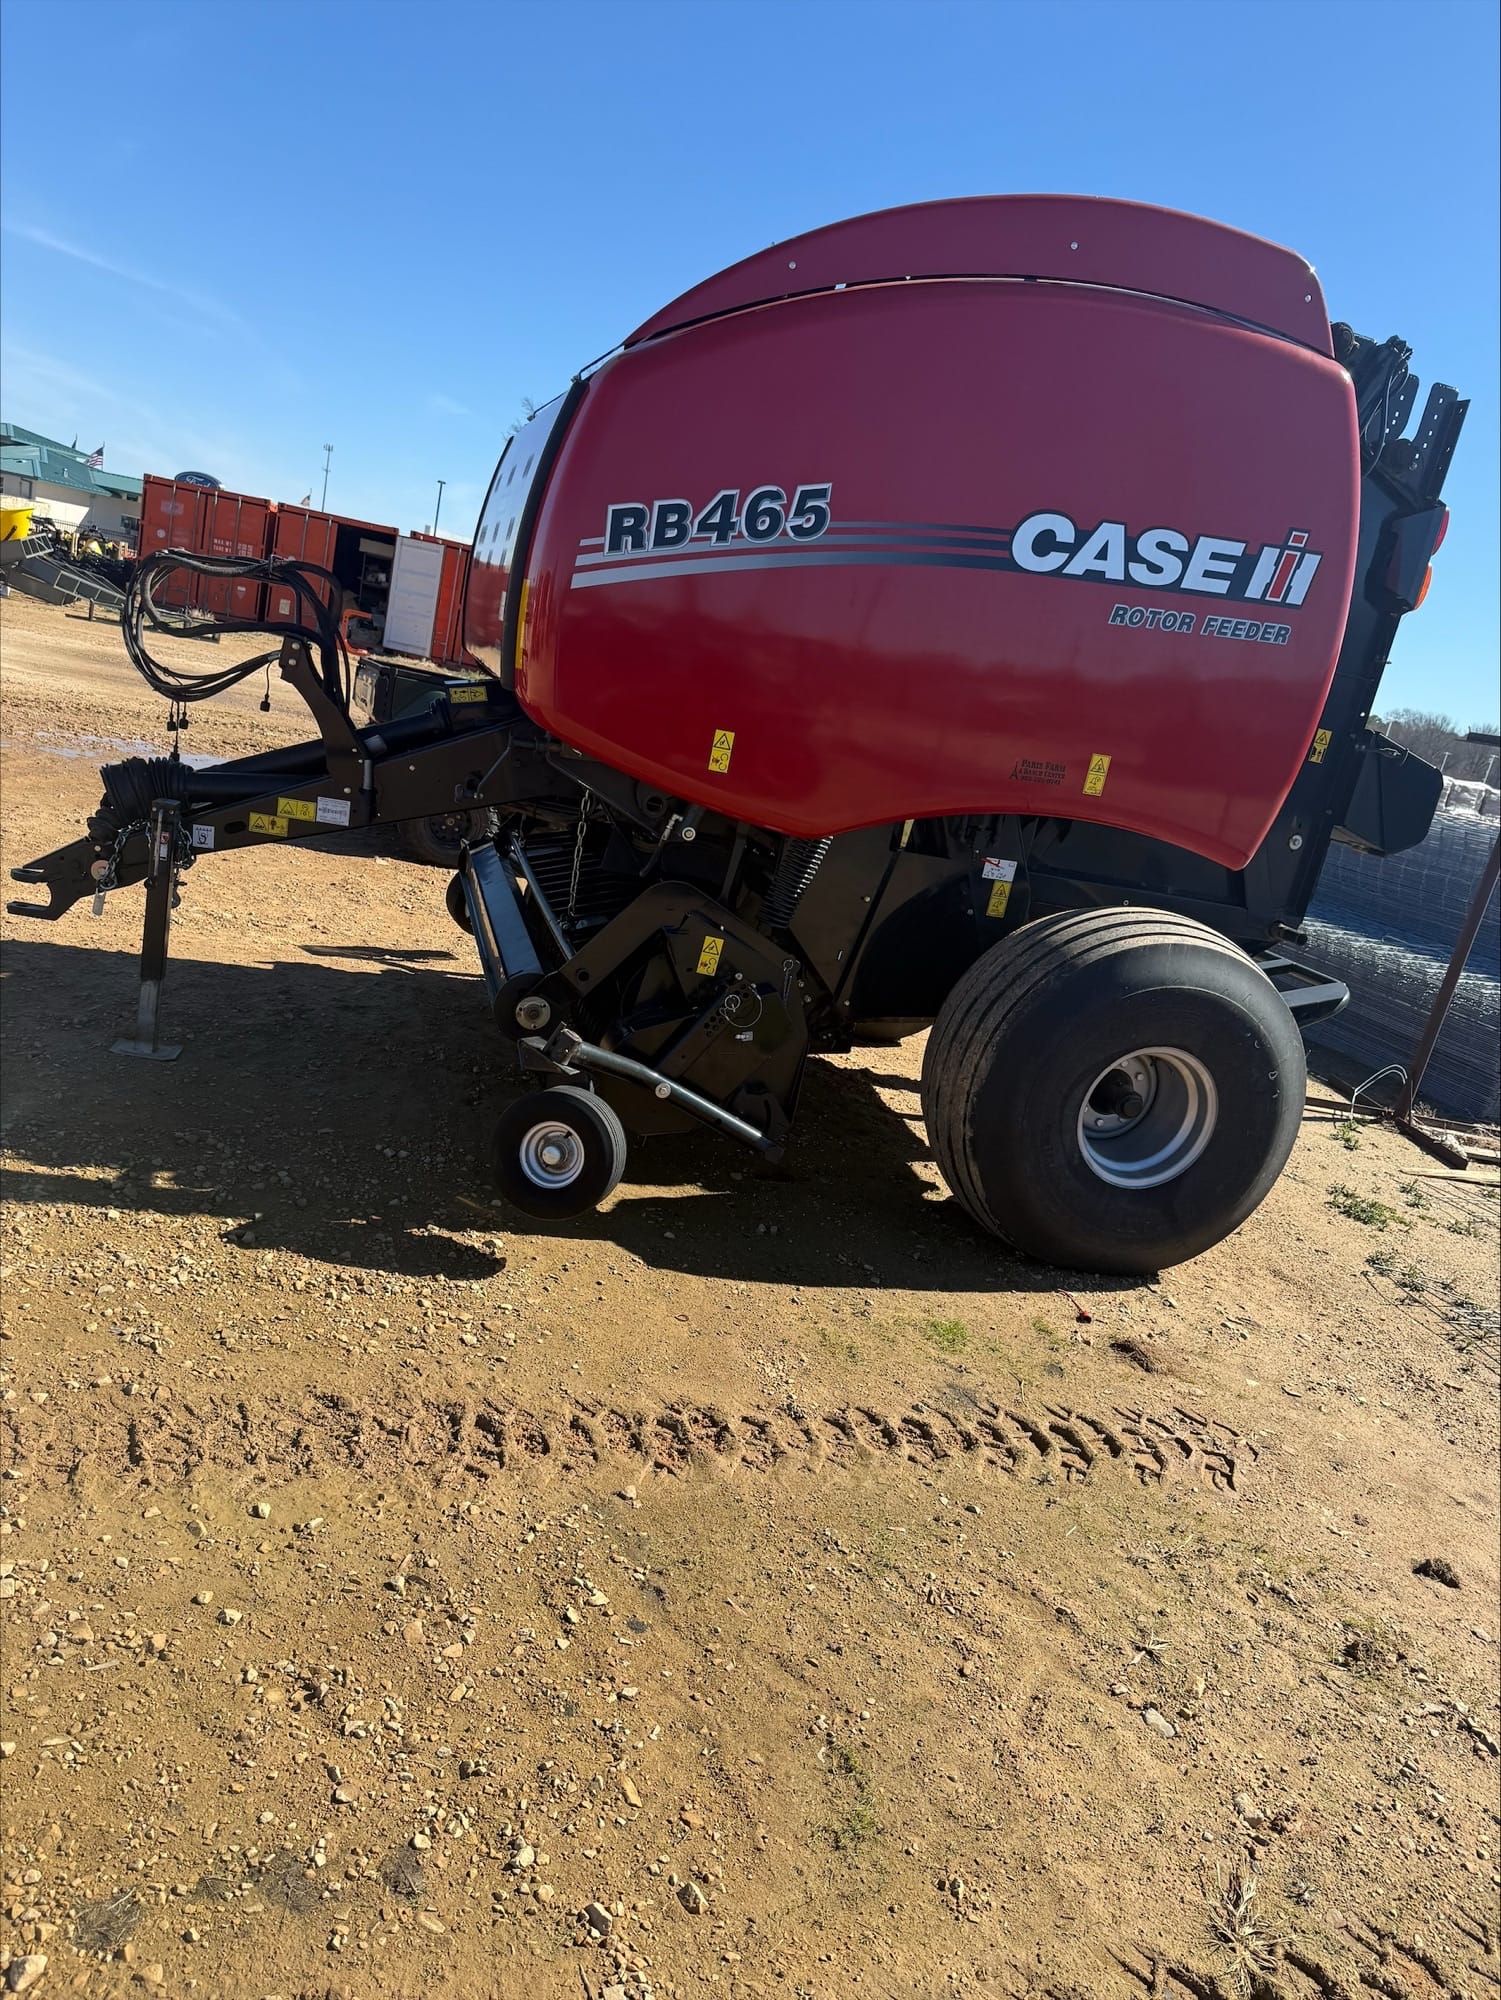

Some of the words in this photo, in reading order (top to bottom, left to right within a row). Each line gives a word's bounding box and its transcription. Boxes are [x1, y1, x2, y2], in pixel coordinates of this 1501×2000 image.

[603, 483, 833, 557] RB465
[1011, 513, 1247, 594] CASE
[1108, 603, 1196, 634] ROTOR
[1200, 615, 1292, 646] FEEDER
